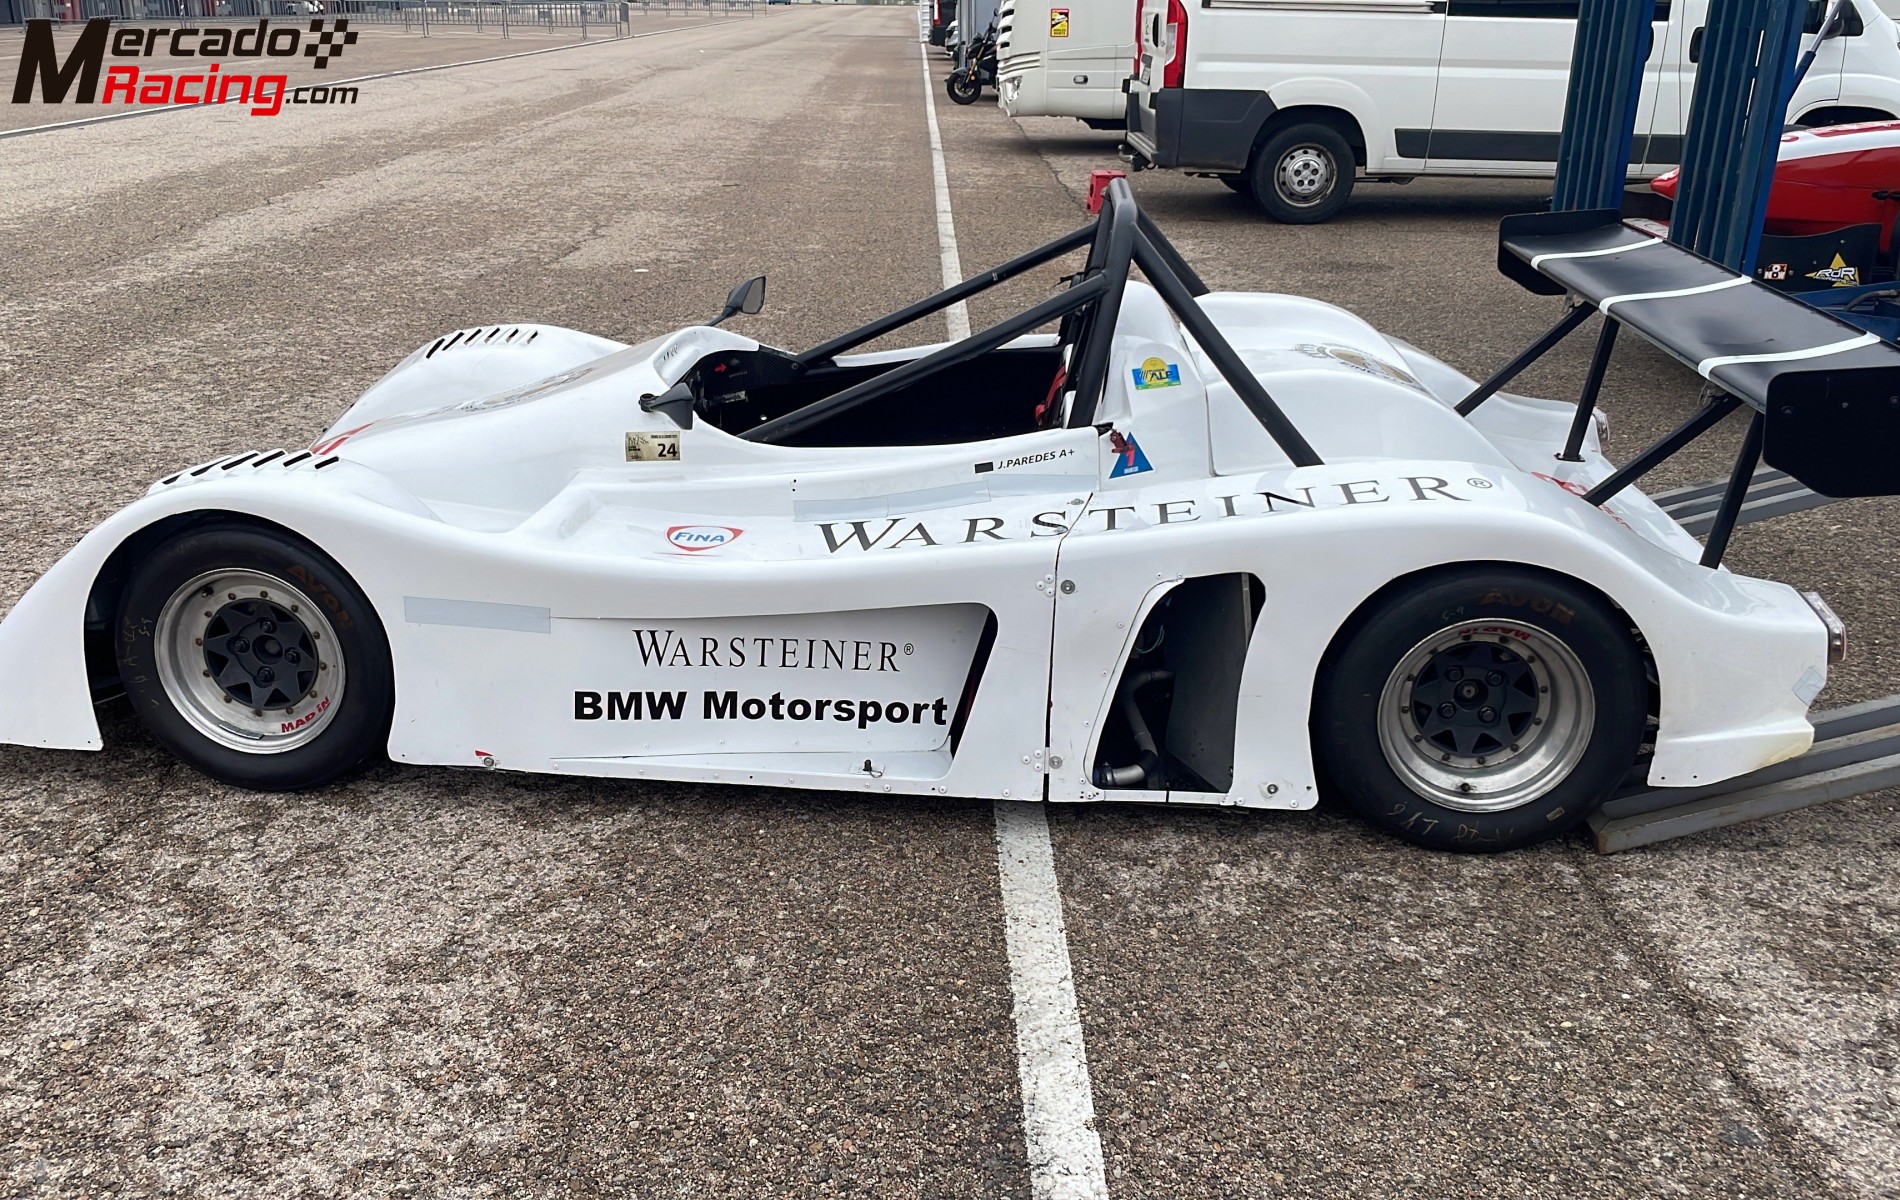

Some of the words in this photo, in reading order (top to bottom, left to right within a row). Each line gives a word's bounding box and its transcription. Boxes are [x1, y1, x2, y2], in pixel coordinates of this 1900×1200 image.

[657, 442, 678, 457] 24
[997, 451, 1056, 469] J.PAREDES
[1058, 449, 1075, 458] A+
[673, 531, 725, 542] FINA
[573, 690, 688, 721] BMW
[702, 690, 948, 730] Motorsport
[281, 712, 316, 733] MAD
